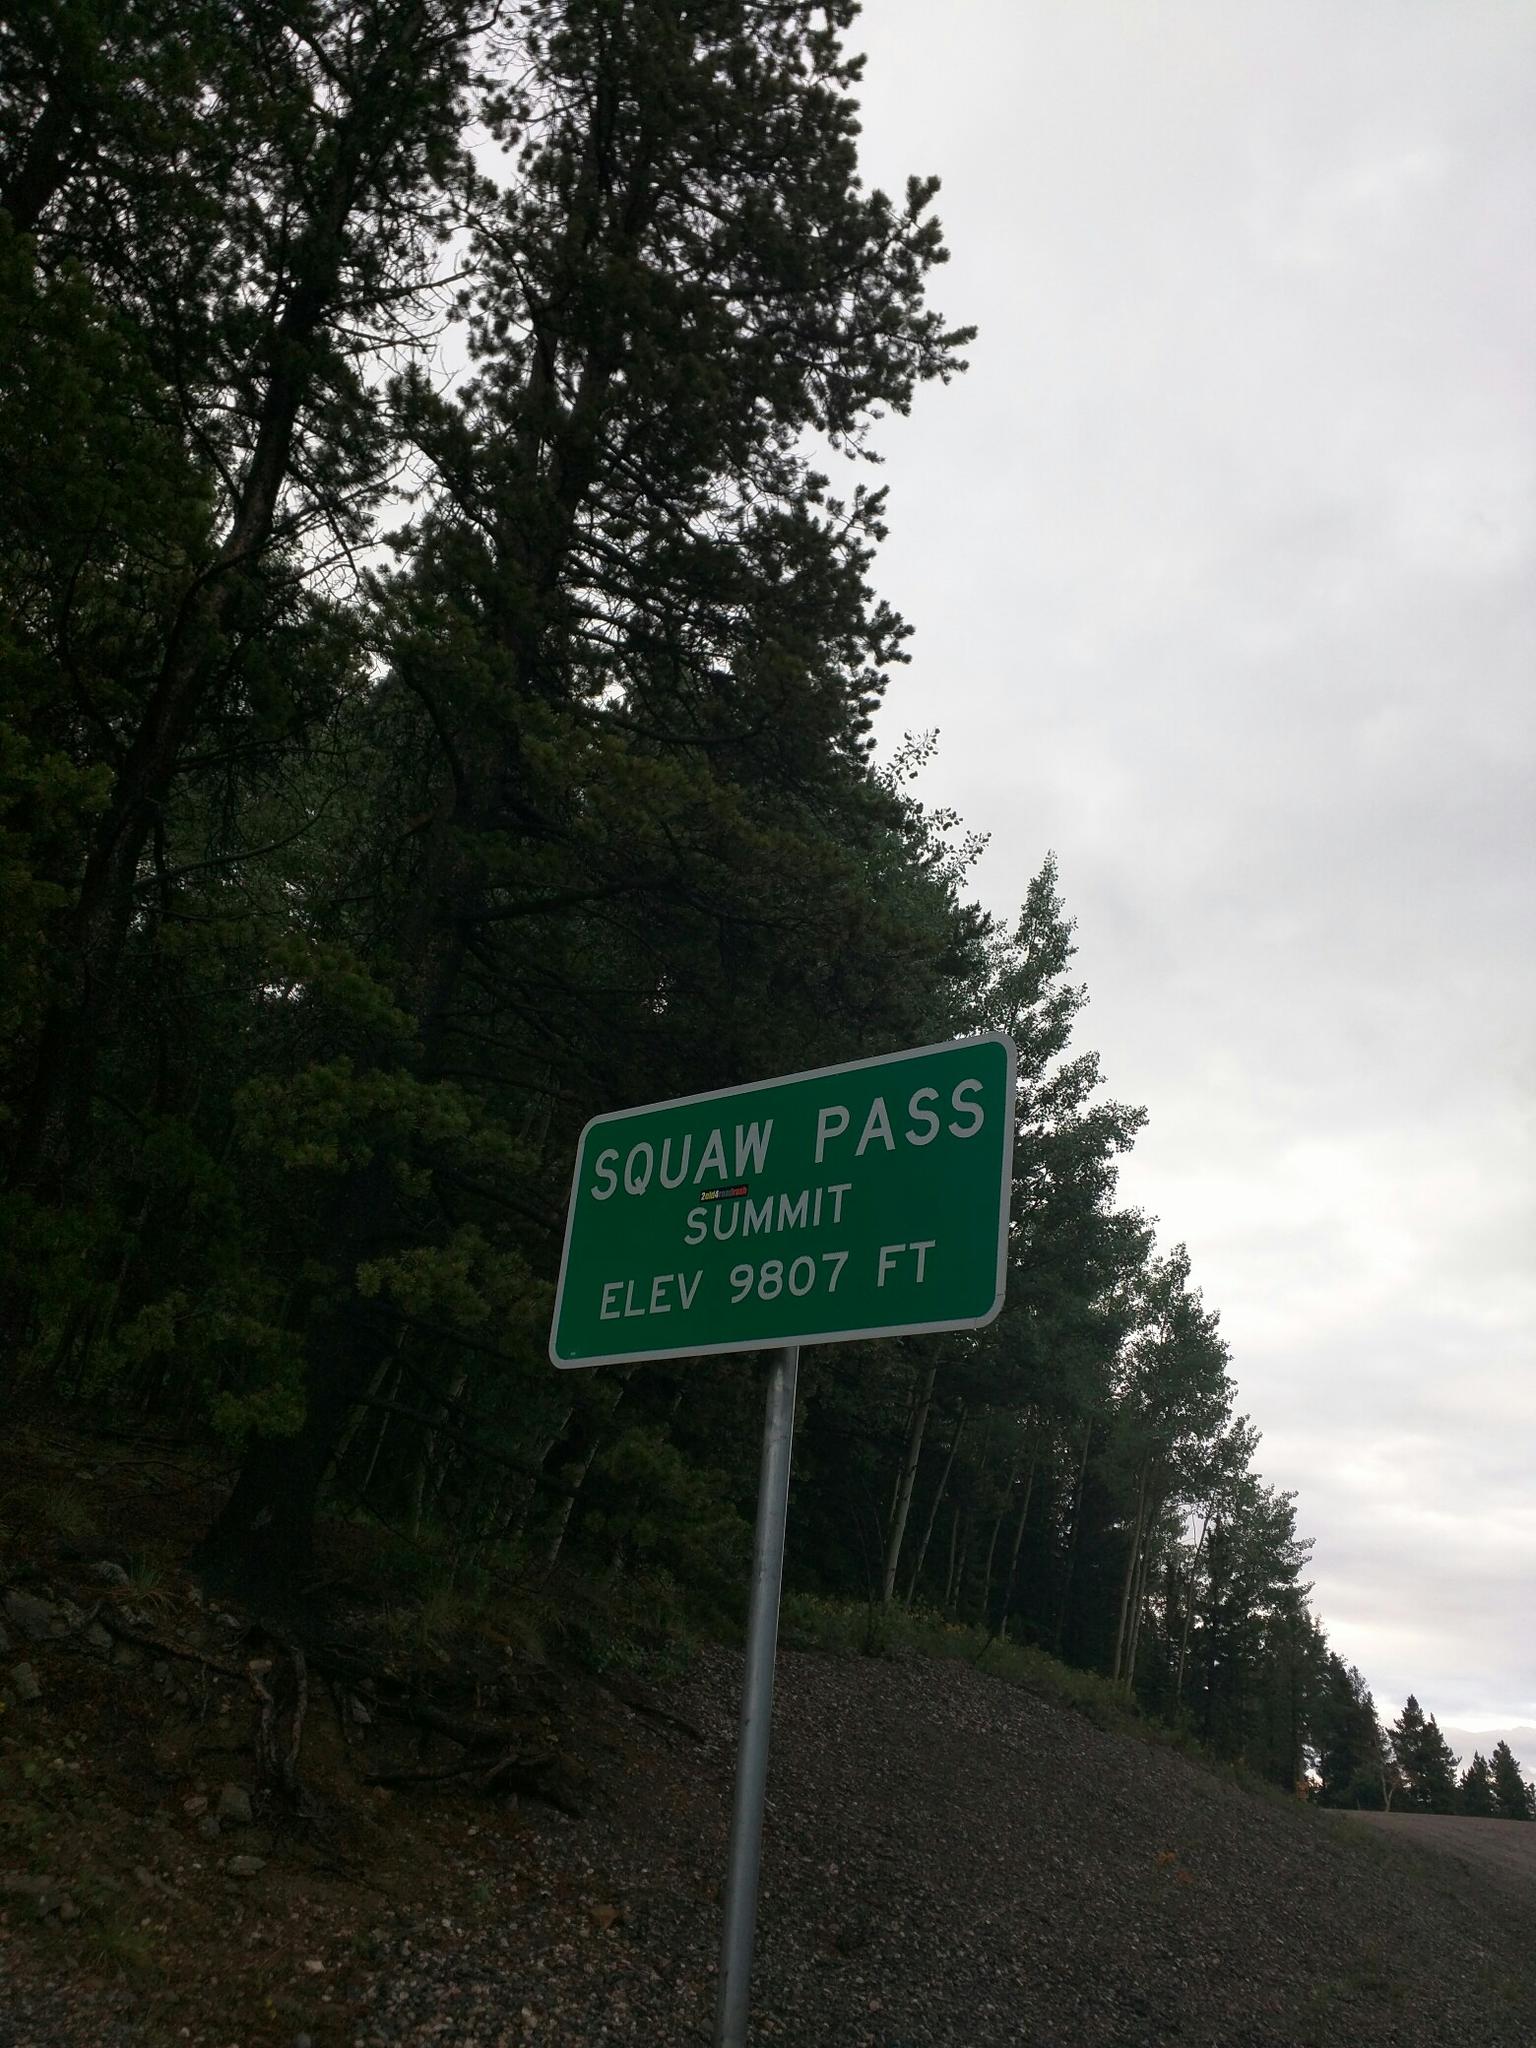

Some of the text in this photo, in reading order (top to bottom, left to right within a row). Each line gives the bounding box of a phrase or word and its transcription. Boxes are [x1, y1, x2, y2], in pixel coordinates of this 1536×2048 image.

[591, 1079, 985, 1201] SQUAW PASS
[684, 1183, 852, 1245] SUMMIT
[599, 1239, 936, 1321] ELEV 9807 FT
